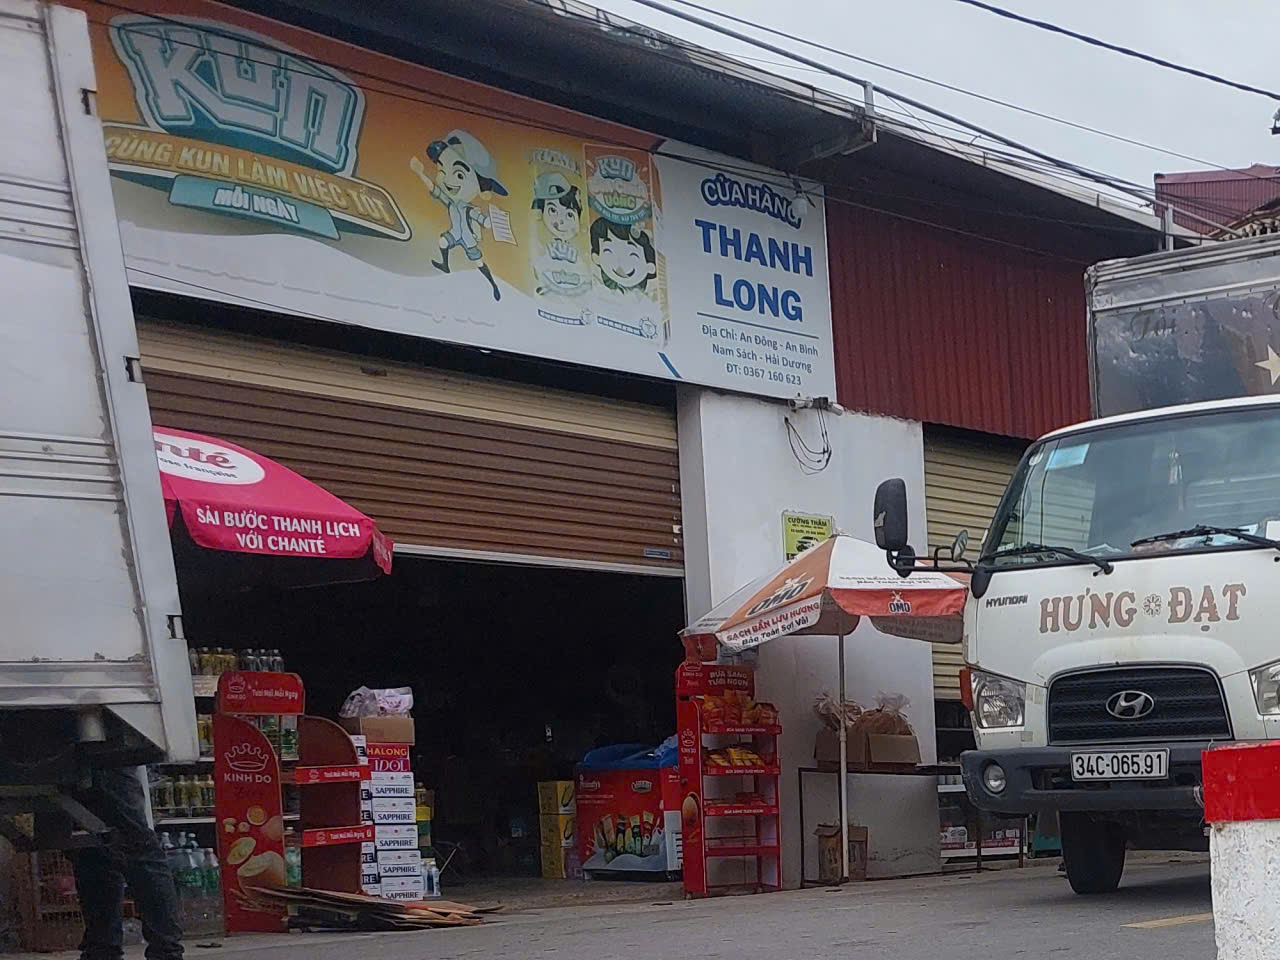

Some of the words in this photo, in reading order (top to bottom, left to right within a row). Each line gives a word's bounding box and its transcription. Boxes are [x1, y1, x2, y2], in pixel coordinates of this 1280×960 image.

[178, 146, 230, 176] KUN
[237, 157, 289, 190] LÀM
[702, 173, 744, 207] CỬA
[253, 194, 299, 223] NGÀY
[695, 219, 813, 277] THANH
[714, 273, 803, 322] LONG
[702, 324, 717, 338] Địa
[740, 332, 752, 344] An
[785, 342, 797, 353] An
[799, 343, 818, 356] Bình
[712, 343, 734, 357] Nam
[736, 347, 757, 361] Sách
[765, 353, 779, 366] Hải
[782, 357, 812, 374] Dương
[726, 362, 741, 375] ĐT:
[743, 367, 765, 379] 0367
[768, 370, 784, 383] 160
[785, 374, 801, 386] 623
[196, 504, 220, 526] SẢI
[224, 509, 268, 530] BƯỚC
[271, 515, 322, 534] THANH
[327, 521, 360, 539] LỊCH
[235, 530, 263, 549] VỚI
[267, 536, 327, 554] CHANTÉ
[747, 581, 808, 617] OMO
[889, 602, 911, 613] OMO
[986, 595, 1029, 608] HYUNDAI
[1039, 587, 1138, 634] HƯNG
[1167, 583, 1247, 632] ĐẠT
[726, 628, 751, 643] SẠCH
[772, 613, 789, 625] LƯU
[790, 602, 820, 618] HƯƠNG
[367, 748, 407, 756] HALONG
[374, 759, 408, 772] IDOL
[1075, 753, 1163, 776] 34C-065.91
[224, 773, 253, 782] KINH
[377, 813, 413, 821] SAPPHIRE
[379, 839, 414, 847] SAPPHIRE
[382, 865, 417, 874] SAPPHIRE
[385, 891, 420, 899] SAPPHIRE
